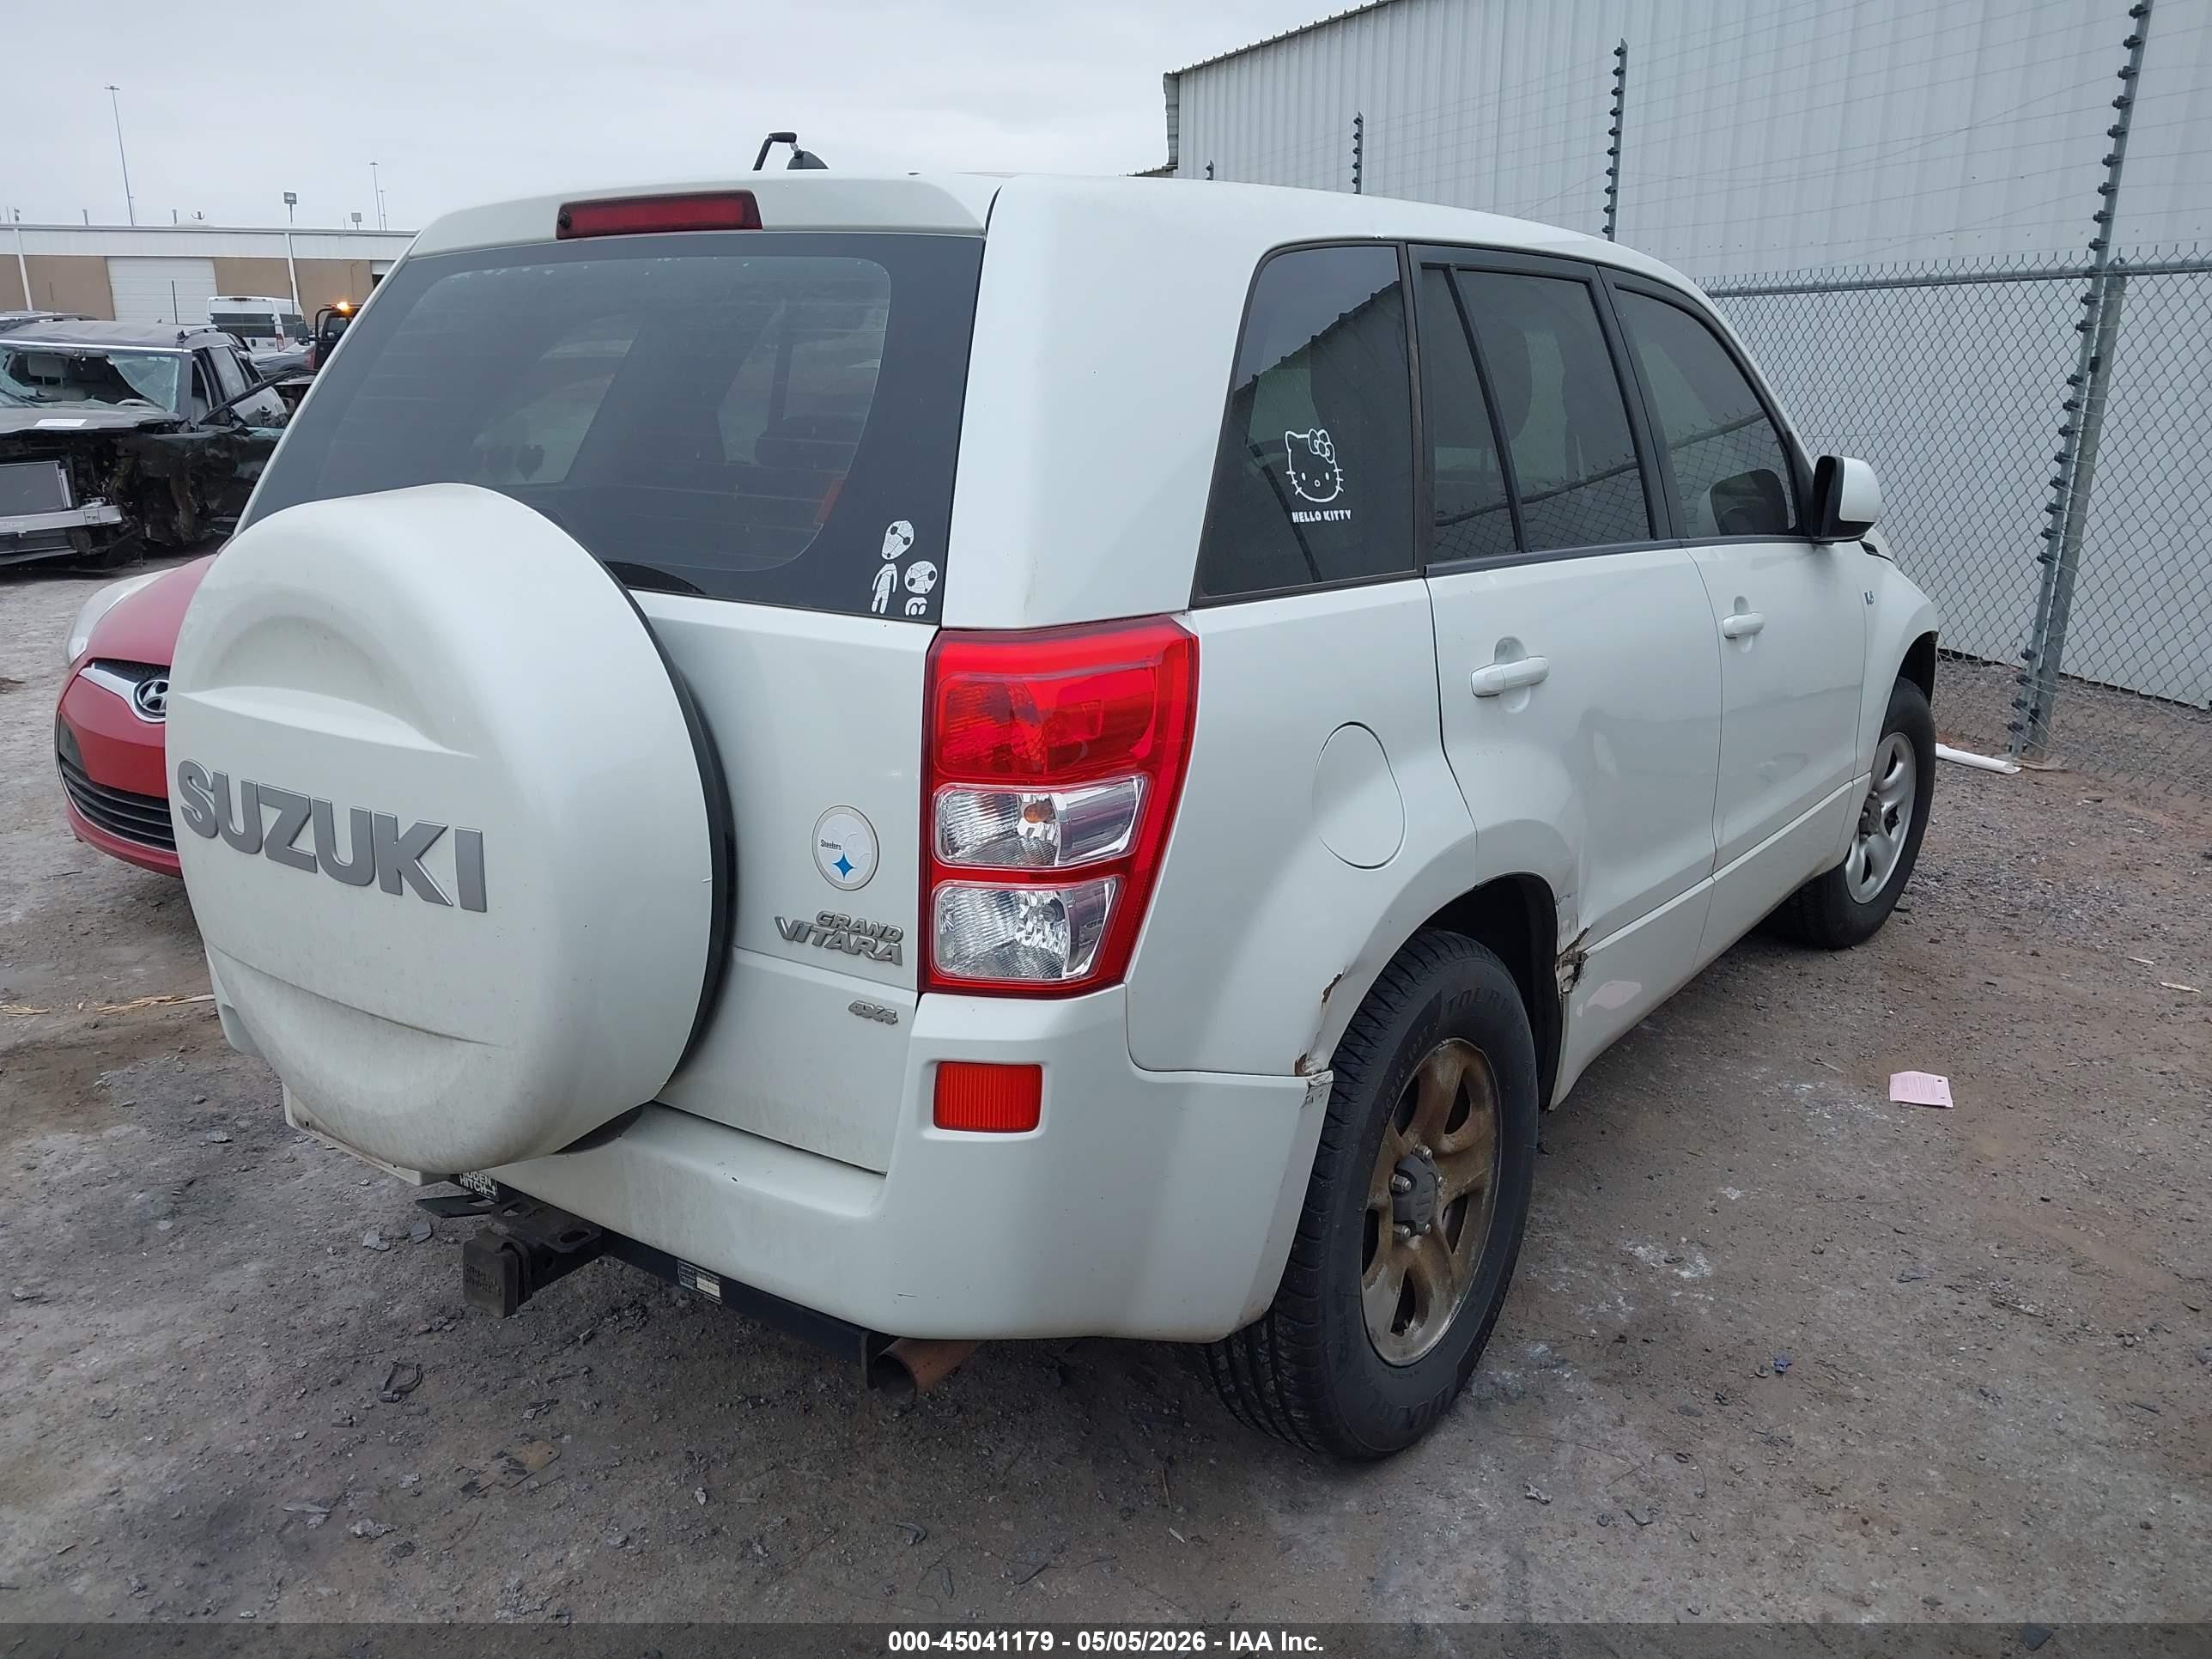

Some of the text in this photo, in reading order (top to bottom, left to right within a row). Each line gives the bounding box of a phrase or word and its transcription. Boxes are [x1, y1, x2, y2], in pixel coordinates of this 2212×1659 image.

[1291, 509, 1352, 523] HELLO KITTY
[177, 758, 487, 913] SUZUKI
[820, 839, 842, 851] Steelers
[815, 910, 904, 943] GRAND
[774, 915, 902, 967] VITARA
[459, 1175, 488, 1194] HITCH
